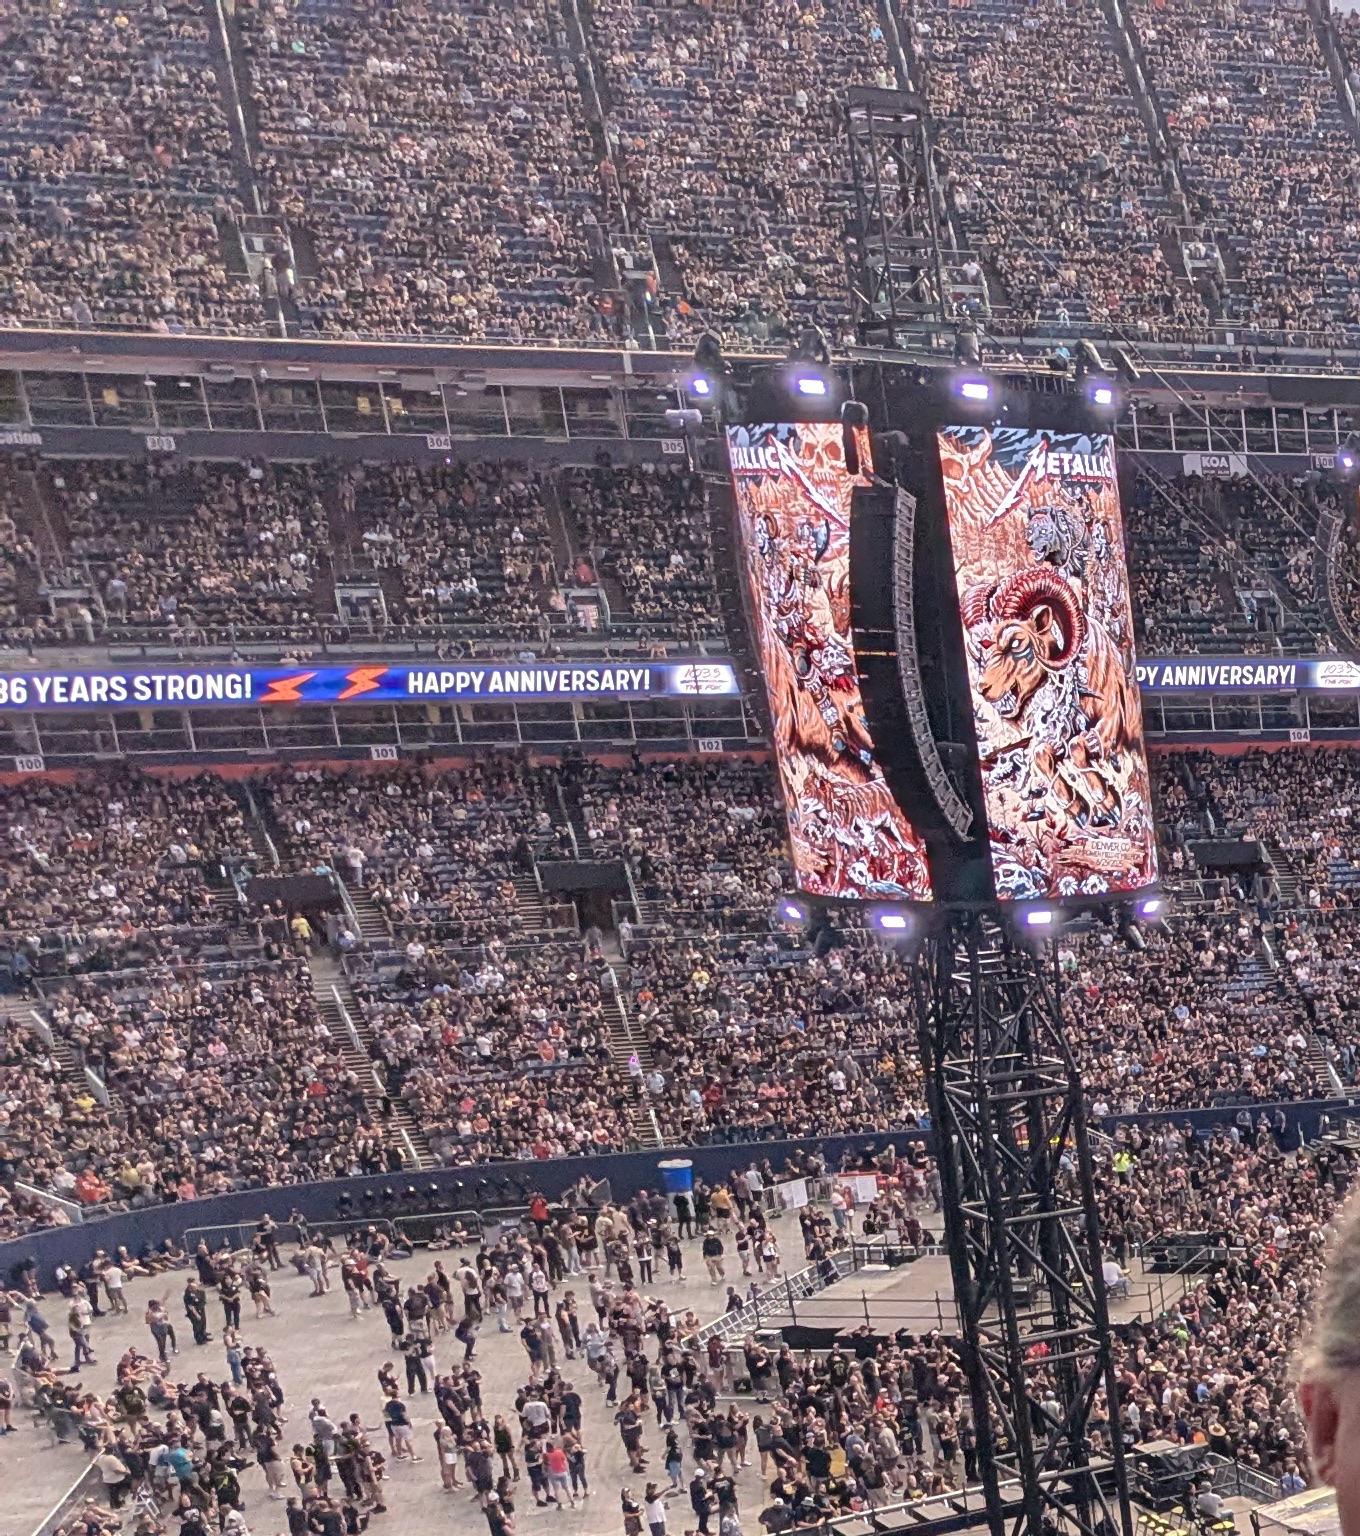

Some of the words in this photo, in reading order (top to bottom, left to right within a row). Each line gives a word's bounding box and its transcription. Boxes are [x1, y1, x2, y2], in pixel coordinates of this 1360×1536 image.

[1201, 457, 1230, 468] KOA
[1161, 665, 1296, 686] ANNIVERSARY!
[408, 671, 484, 694] HAPPY
[488, 669, 650, 693] ANNIVERSARY!
[32, 676, 127, 702] YEARS
[134, 673, 251, 701] STRONG!
[1292, 731, 1308, 741] 104
[702, 740, 720, 750] 102
[374, 747, 394, 758] 101
[18, 758, 42, 769] 100
